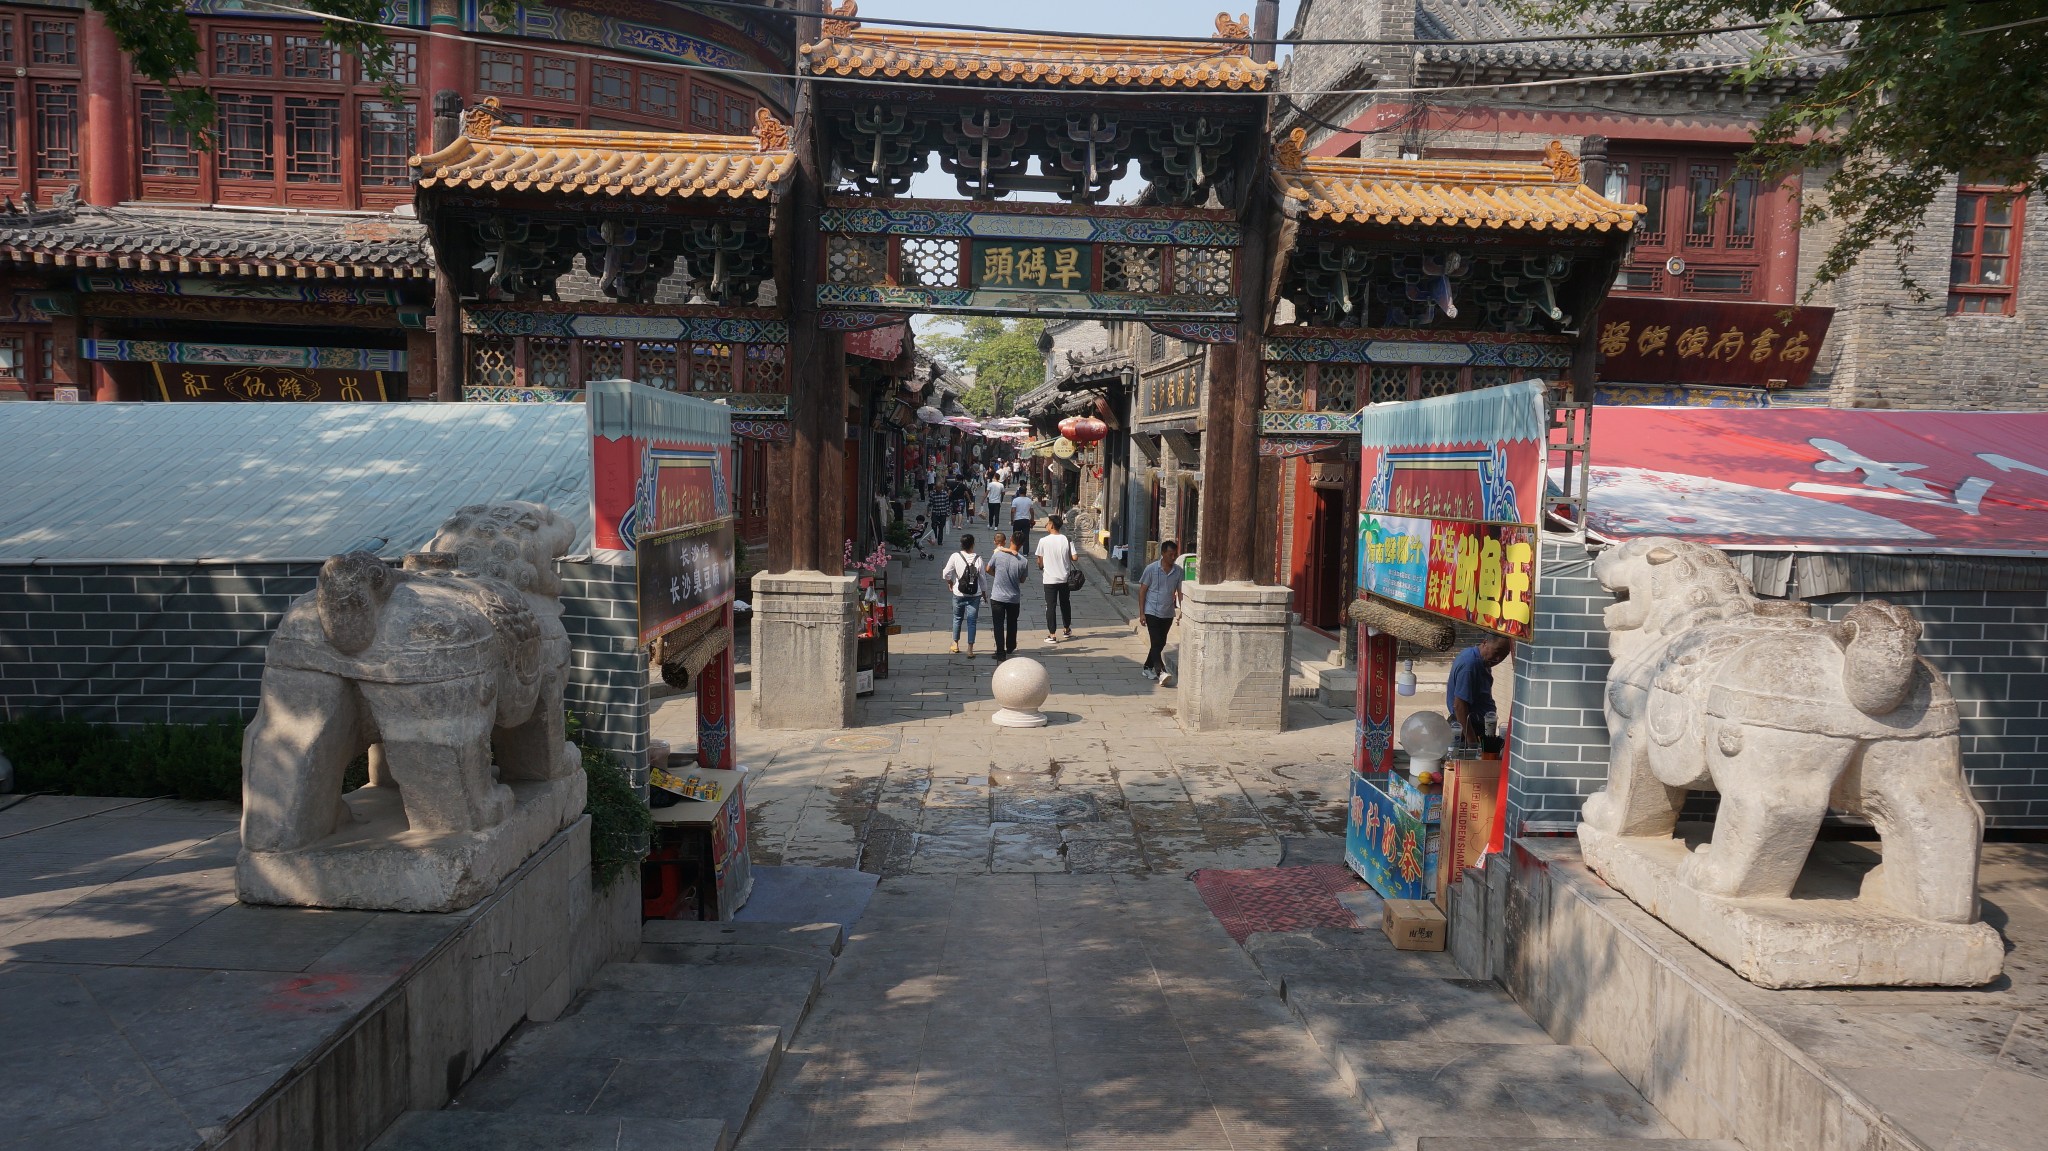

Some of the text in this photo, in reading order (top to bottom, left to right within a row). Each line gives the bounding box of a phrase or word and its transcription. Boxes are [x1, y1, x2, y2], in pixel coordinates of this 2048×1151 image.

[1432, 524, 1456, 564] 大连
[669, 561, 720, 605] 长沙臭豆腐
[1428, 569, 1453, 611] 铁板
[1453, 532, 1532, 625] 鱿鱼王
[1350, 794, 1422, 883] 椰汁奶茶
[1457, 802, 1468, 841] CHILDREN
